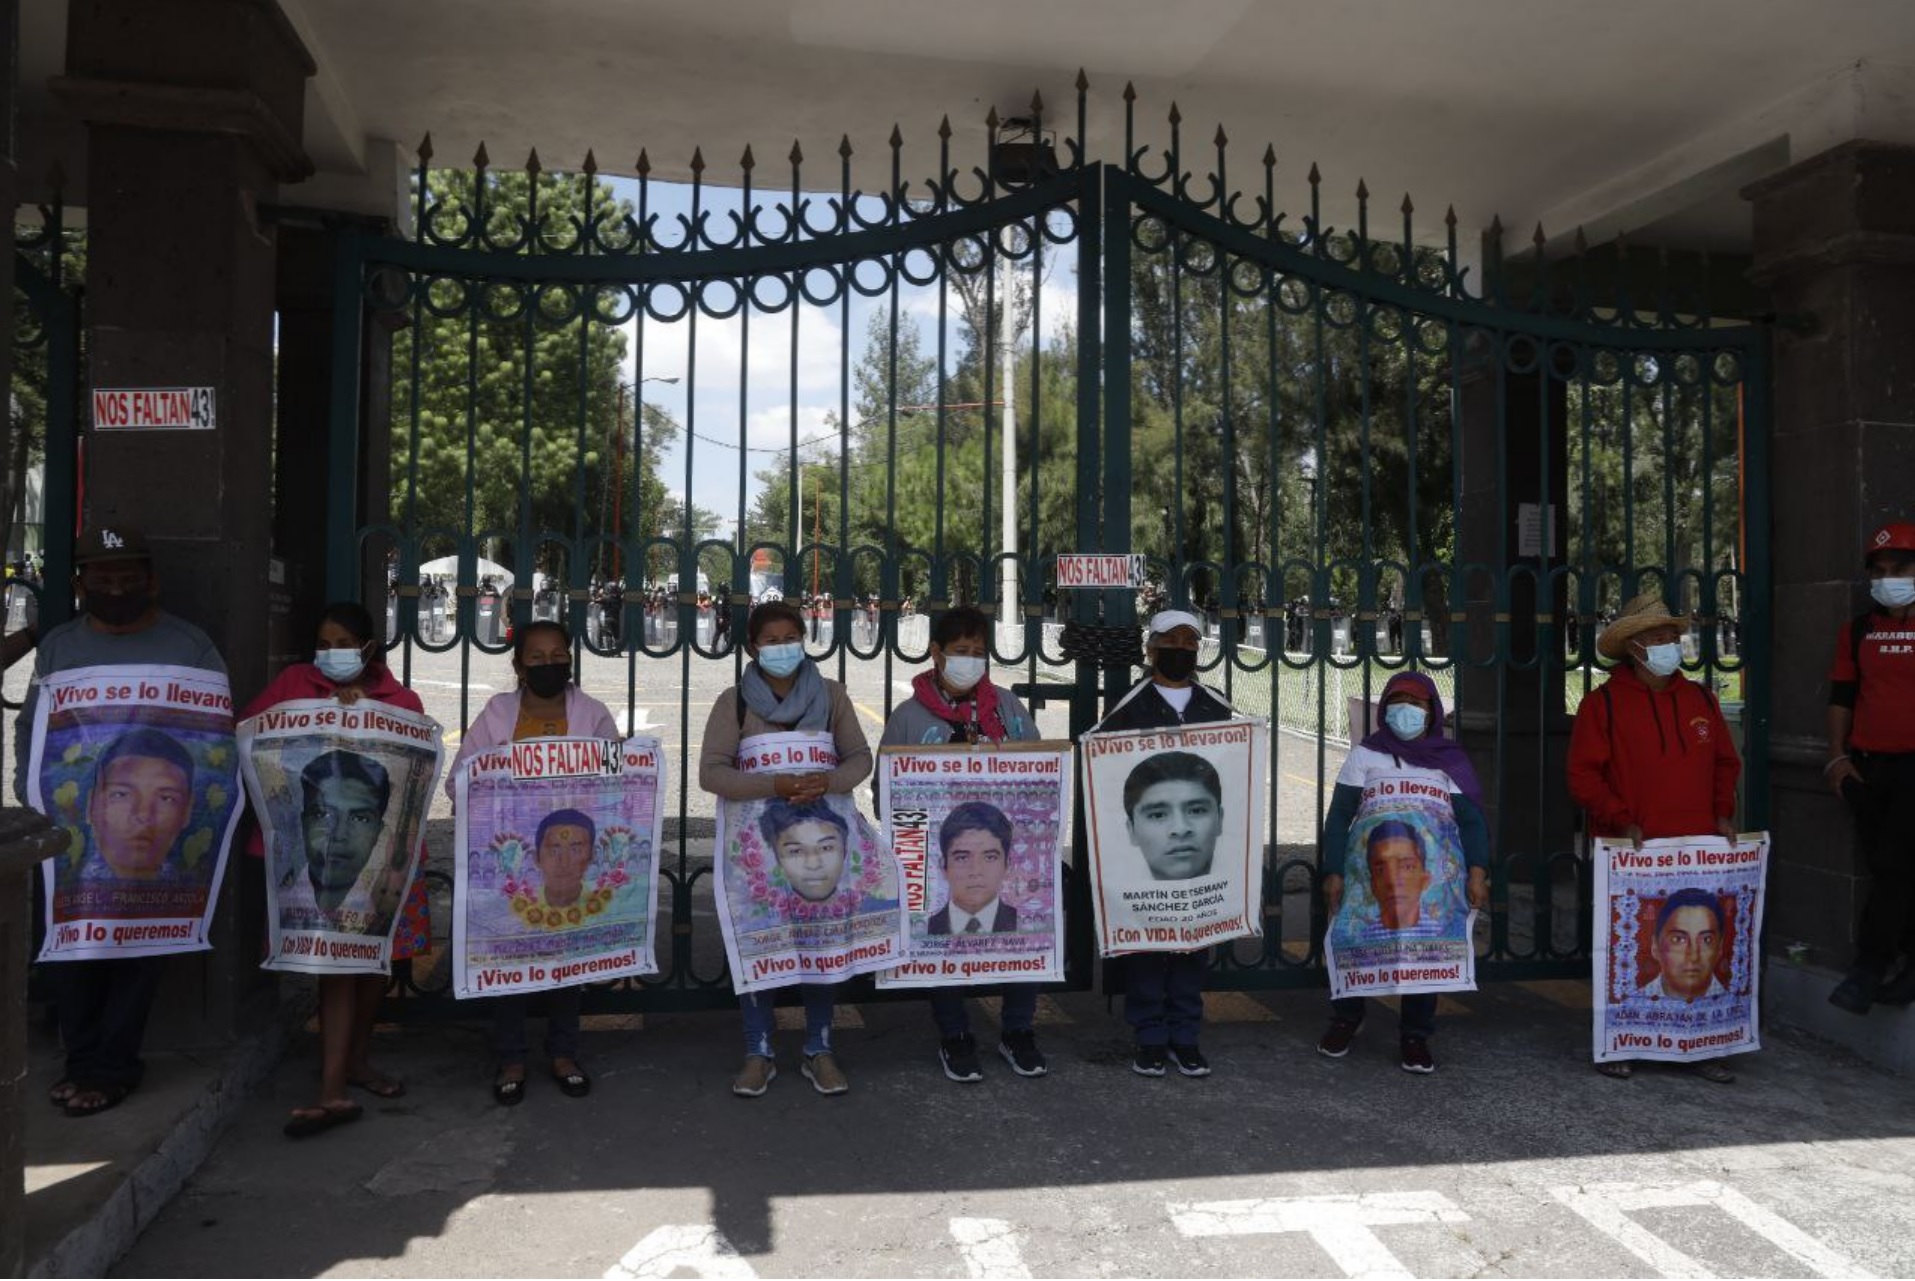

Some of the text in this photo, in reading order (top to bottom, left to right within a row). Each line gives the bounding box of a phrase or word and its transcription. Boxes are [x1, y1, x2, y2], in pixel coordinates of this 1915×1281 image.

[96, 393, 128, 425] NOS
[102, 530, 125, 548] LA
[1059, 556, 1083, 584] NOS
[105, 686, 131, 700] se
[138, 682, 159, 700] lo
[259, 711, 433, 743] ¡Vivo se lo llevaron!
[1092, 727, 1247, 757] ¡Vivo se lo llevaron!
[512, 745, 543, 776] NOS
[761, 751, 782, 766] se
[787, 746, 804, 764] lo
[893, 757, 1060, 777] ¡Vivo se lo llevaron!
[1380, 781, 1395, 795] lo
[1612, 847, 1759, 870] ¡Vivo se lo llevaron!
[1123, 880, 1229, 900] MARTÍN GETSEMANY
[1132, 901, 1190, 912] SÁNCHEZ
[85, 922, 107, 941] lo
[112, 920, 194, 946] queremos!
[1113, 927, 1140, 946] ¡Con
[1144, 927, 1177, 942] VIDA
[314, 936, 327, 956] lo
[330, 941, 381, 961] queremos!
[752, 958, 796, 980] ¡Vivo
[799, 953, 812, 969] lo
[816, 938, 891, 972] queremos!
[477, 950, 637, 990] ¡Vivo lo queremos!
[942, 960, 956, 974] lo
[961, 955, 1046, 977] queremos!
[1345, 965, 1460, 989] ¡Vivo lo queremos!
[1613, 1026, 1744, 1052] ¡Vivo lo queremos!
